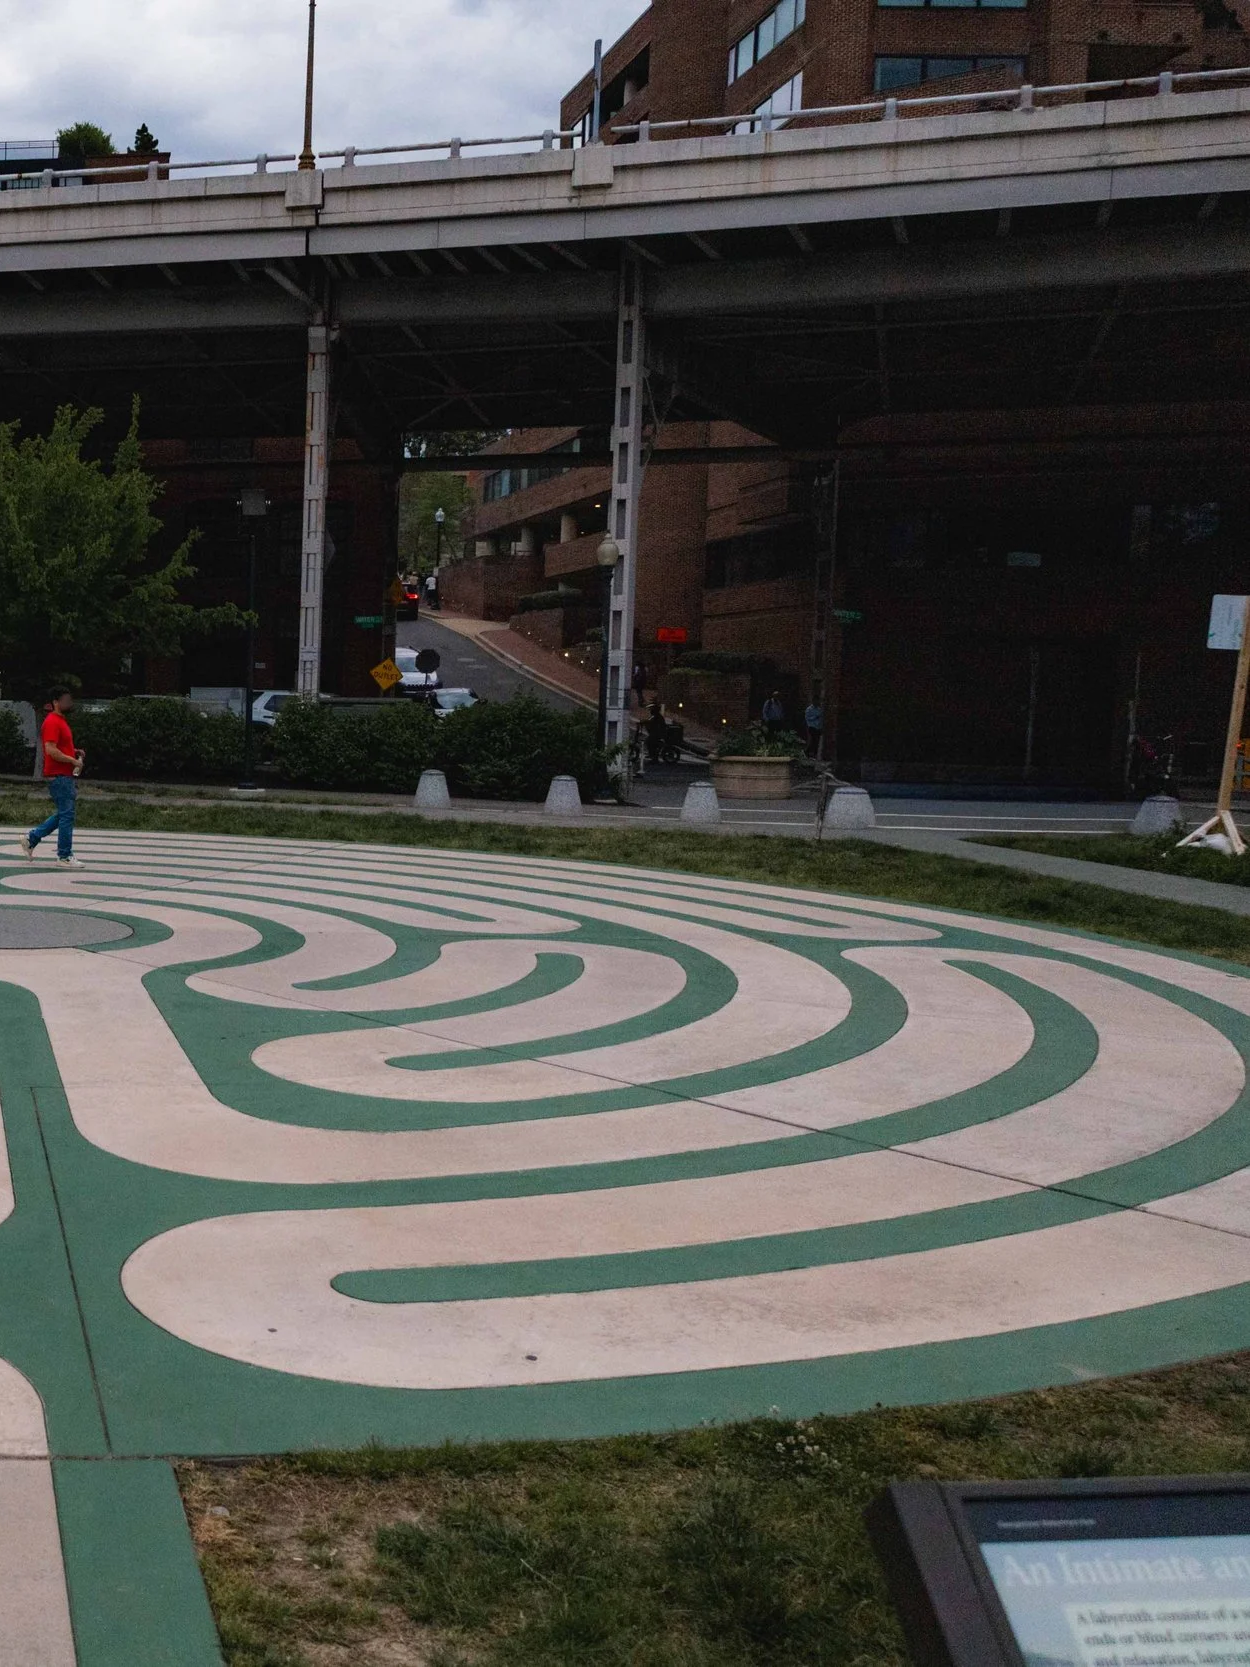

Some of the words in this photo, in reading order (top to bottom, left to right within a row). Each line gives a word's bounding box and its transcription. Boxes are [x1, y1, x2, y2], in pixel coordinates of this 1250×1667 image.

[373, 671, 398, 680] OUTLET
[1003, 1554, 1053, 1587] An
[1057, 1551, 1206, 1585] Intimate
[1089, 1609, 1154, 1628] labyrinth
